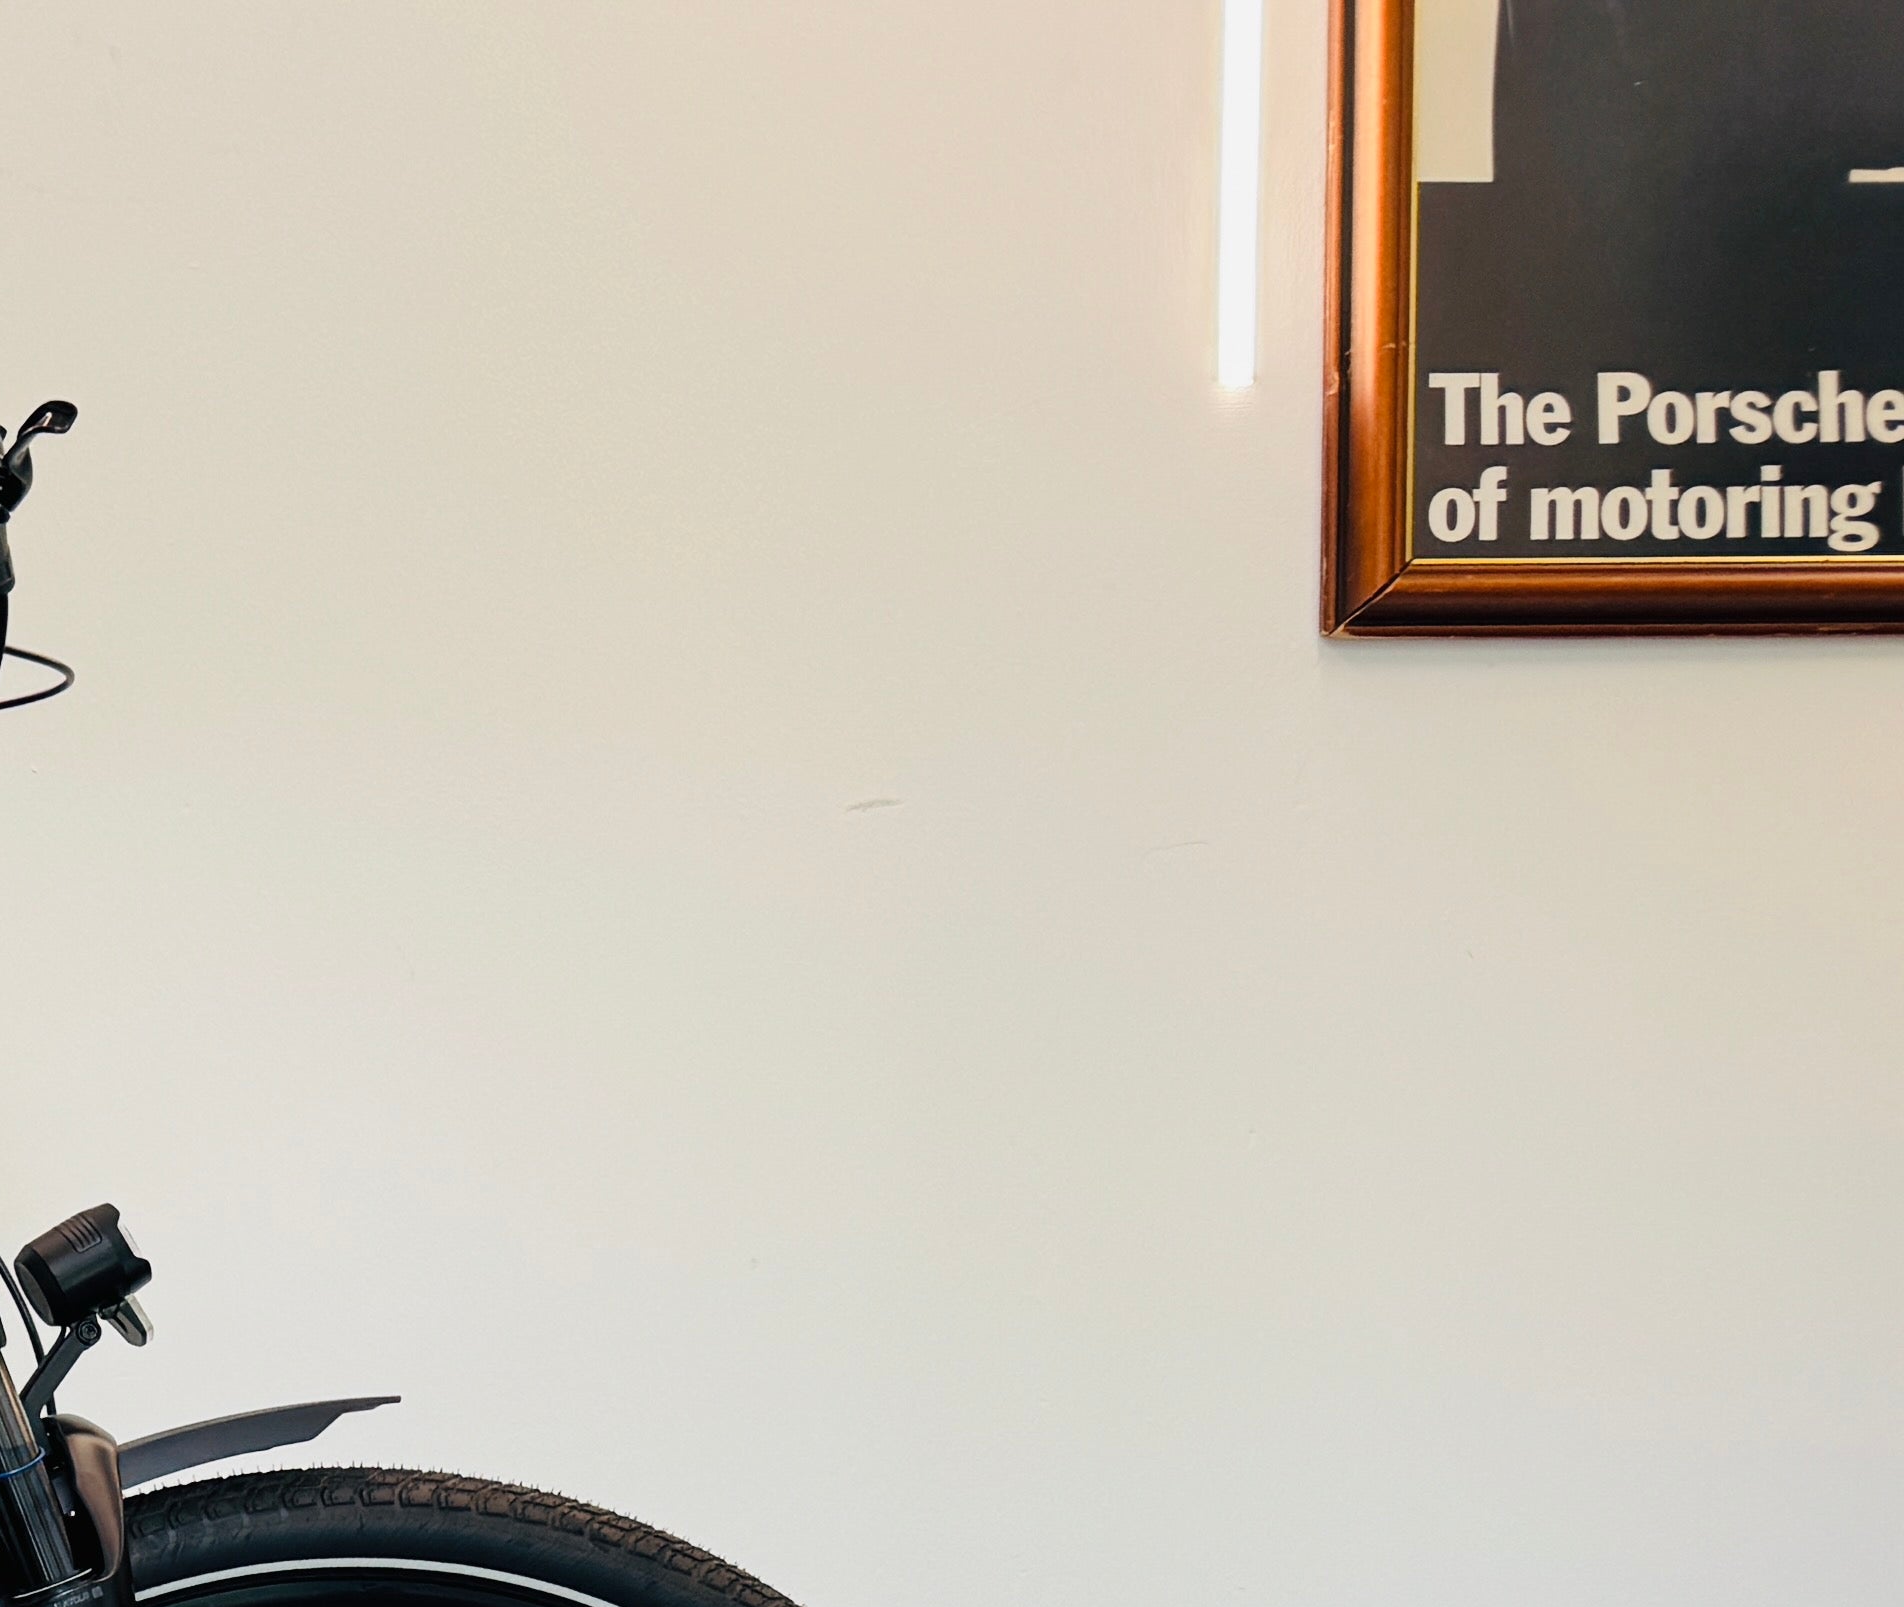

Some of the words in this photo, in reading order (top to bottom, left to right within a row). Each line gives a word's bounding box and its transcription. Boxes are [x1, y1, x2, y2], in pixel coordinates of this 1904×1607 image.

[1428, 371, 1572, 447] The
[1597, 369, 1904, 445] Porsche
[1428, 465, 1508, 543] of
[1530, 464, 1882, 552] motoring
